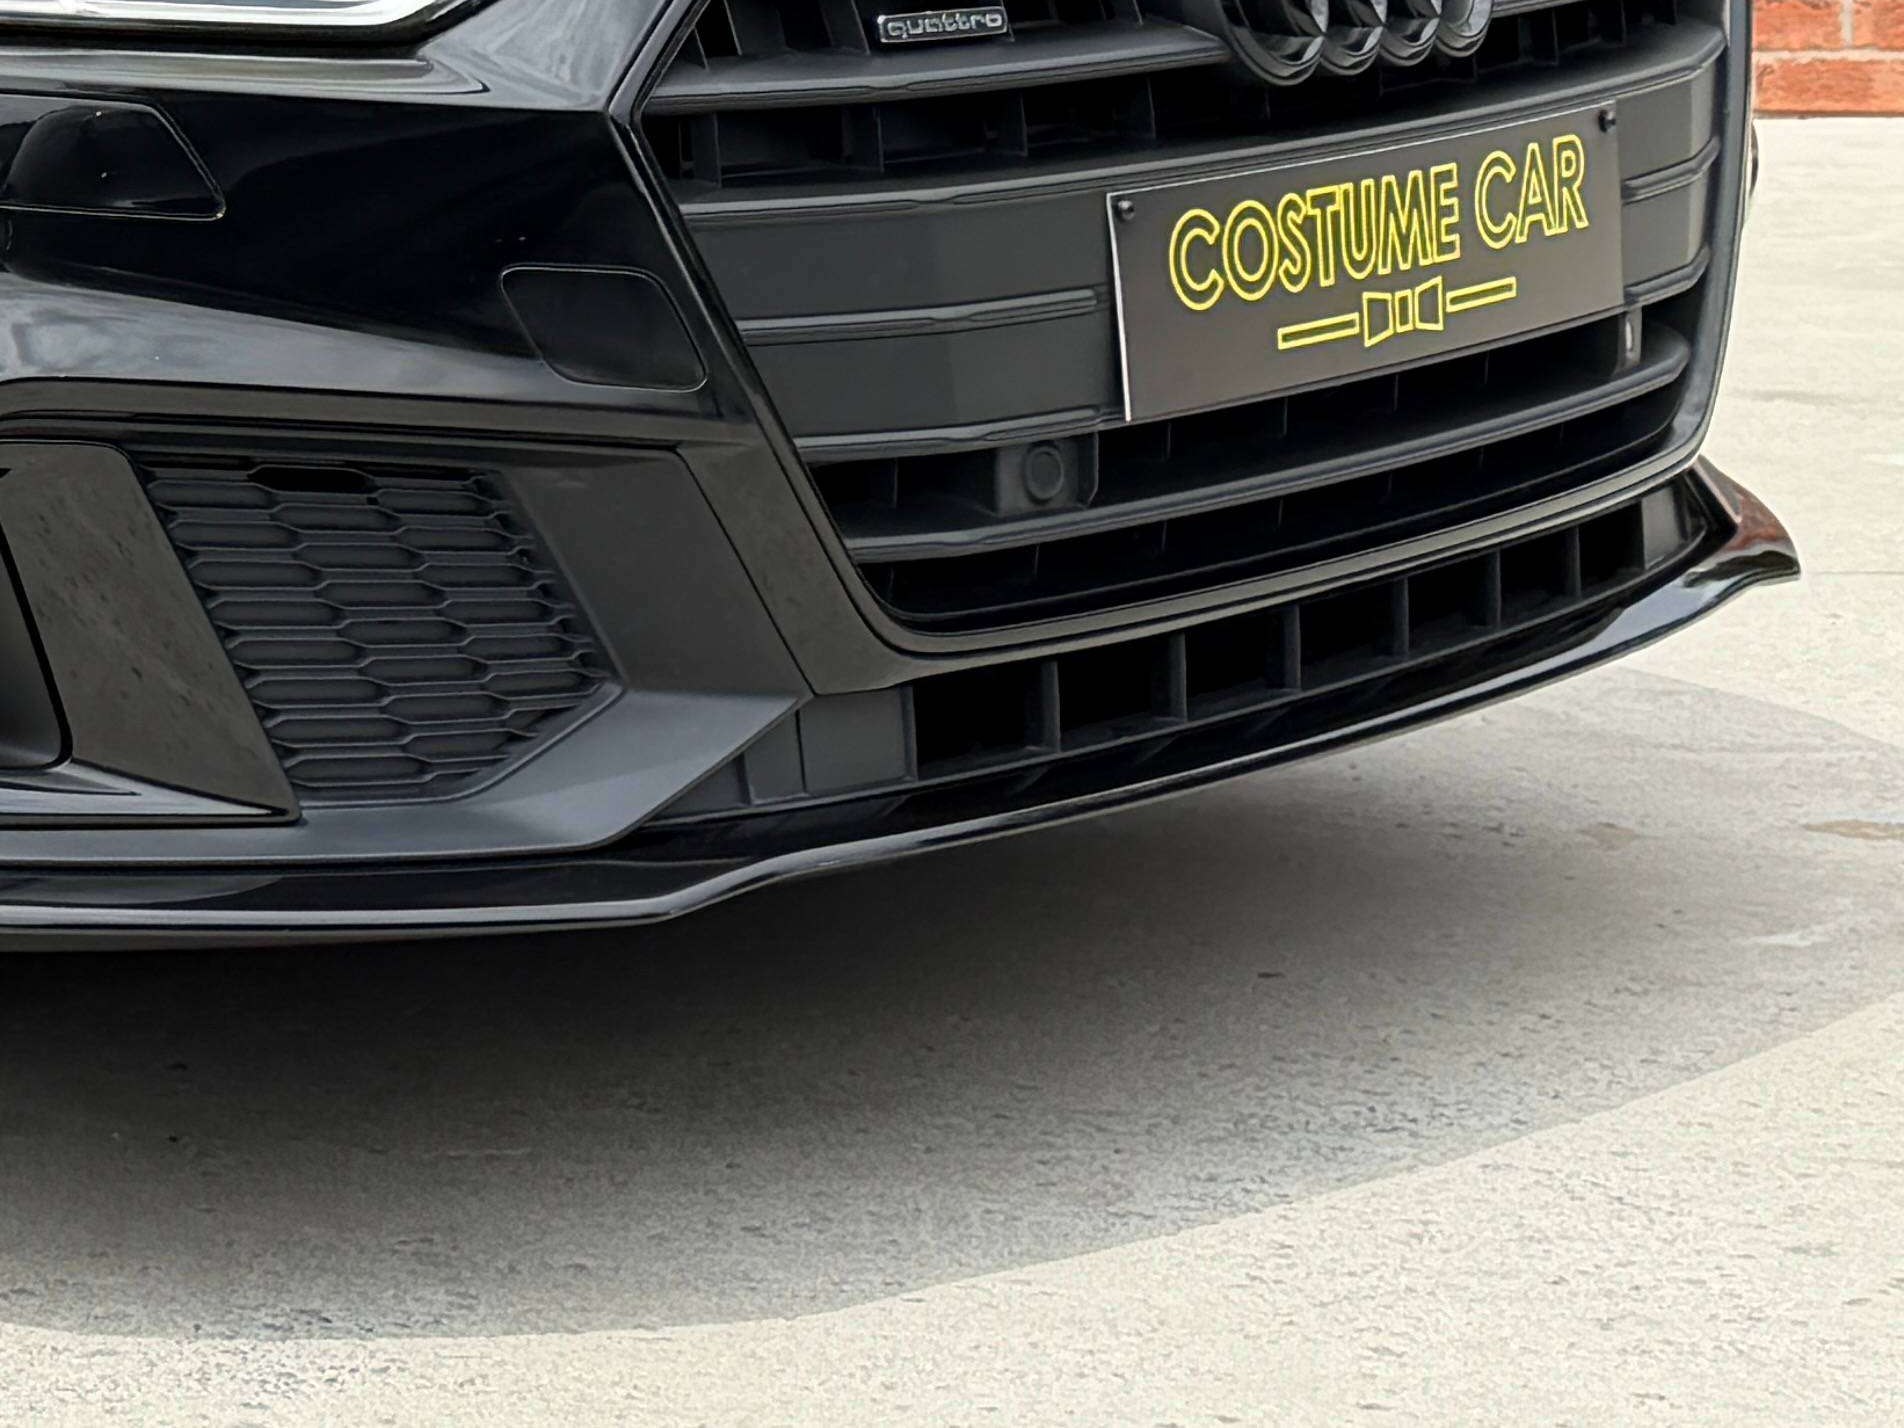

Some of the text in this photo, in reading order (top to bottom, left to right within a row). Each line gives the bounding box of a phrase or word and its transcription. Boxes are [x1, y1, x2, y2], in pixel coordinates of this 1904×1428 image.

[887, 12, 1003, 40] quattro
[1169, 133, 1589, 311] COSTUME CAR
